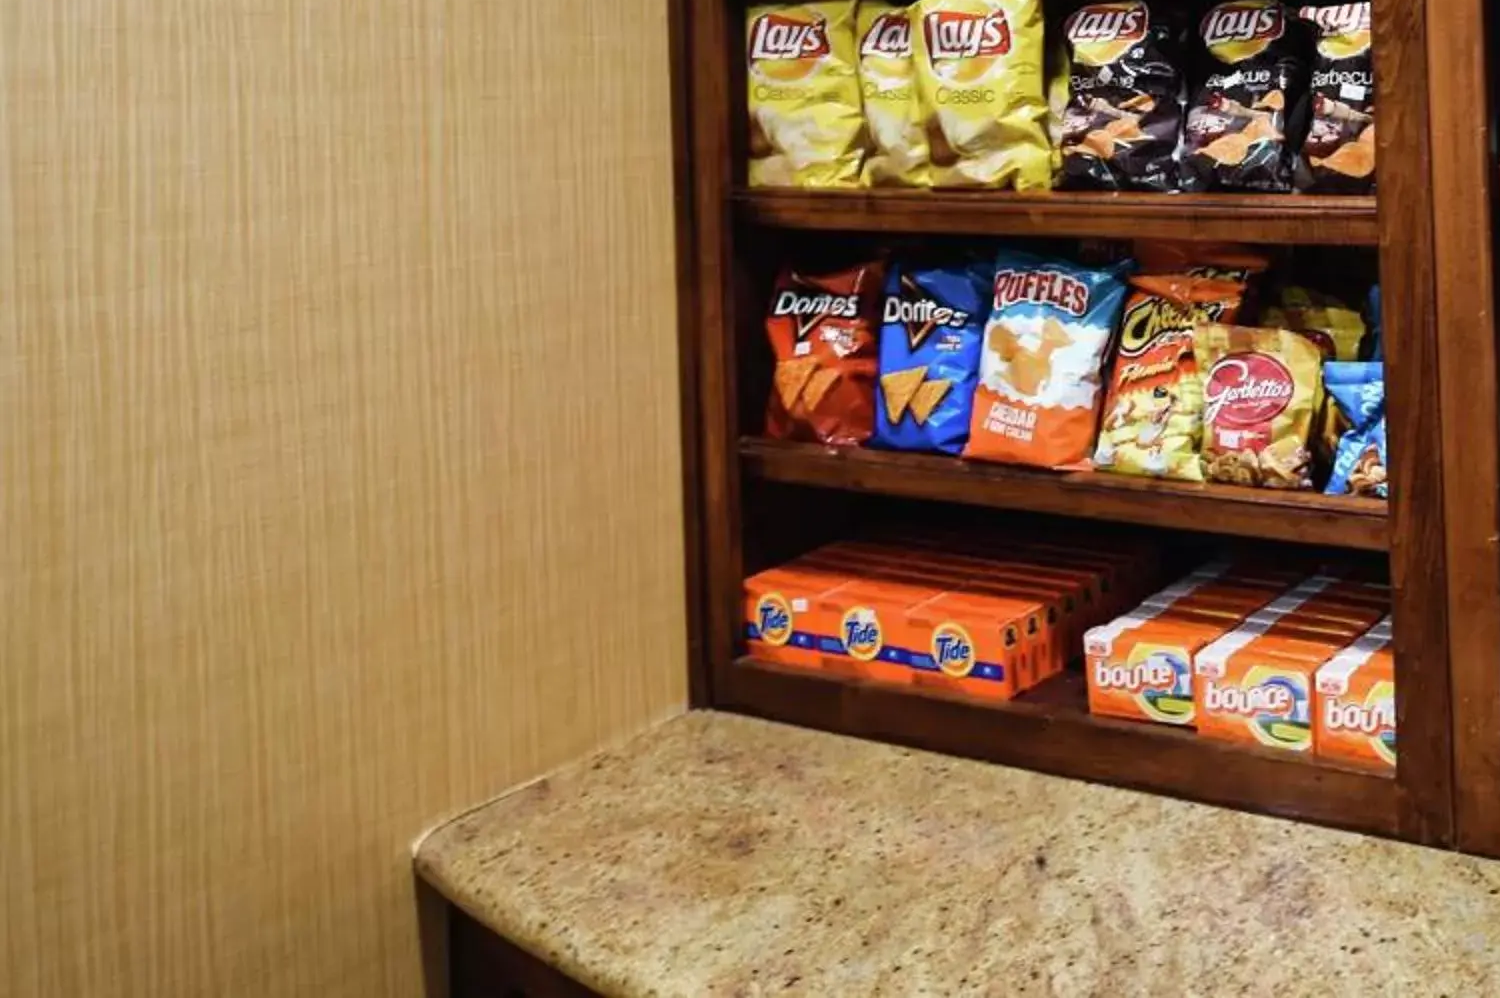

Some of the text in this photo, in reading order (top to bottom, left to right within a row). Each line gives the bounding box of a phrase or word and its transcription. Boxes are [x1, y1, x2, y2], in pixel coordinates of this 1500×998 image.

[936, 87, 996, 105] Classic
[774, 290, 858, 316] Doritos
[994, 269, 1090, 317] RUFFLES
[884, 297, 969, 327] Doritos
[1205, 359, 1292, 424] Gardetto's
[760, 606, 789, 633] Tide
[845, 621, 879, 644] Tide
[936, 637, 971, 663] Tide
[1095, 661, 1171, 689] bounce
[1206, 682, 1289, 712] bounce
